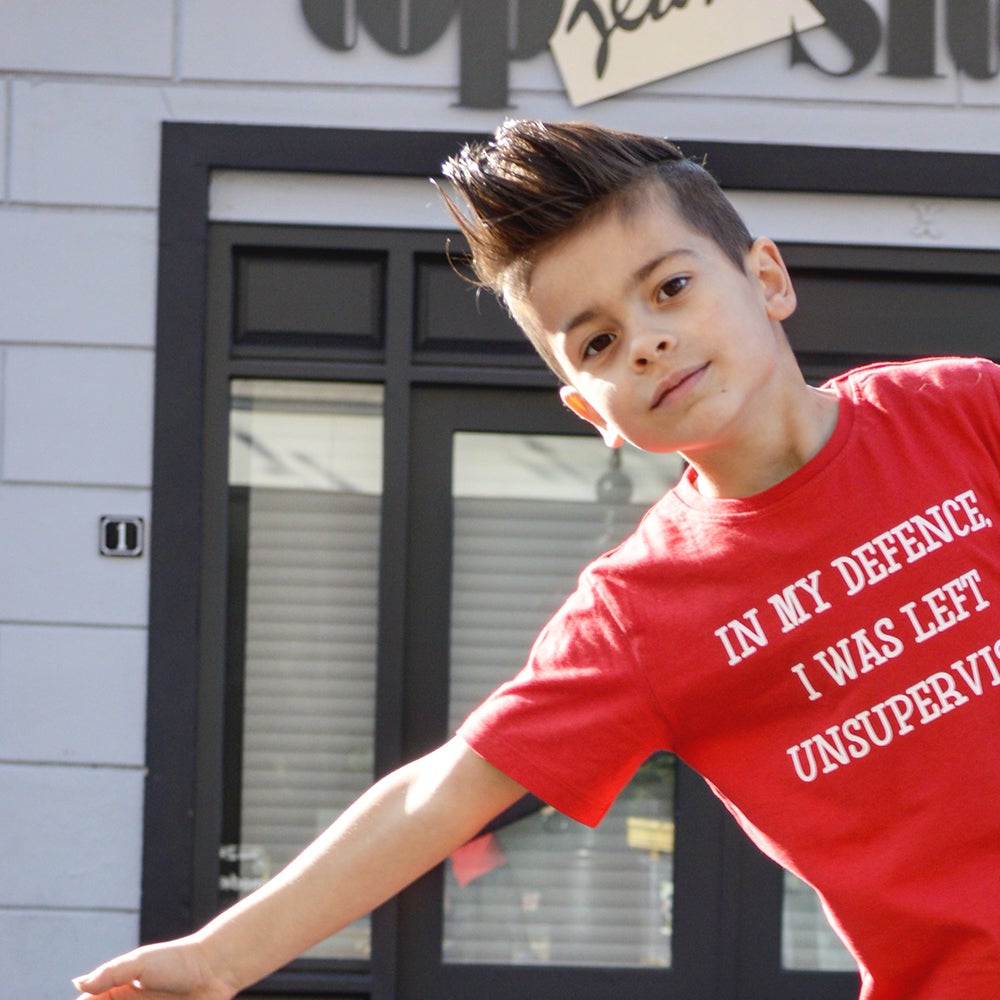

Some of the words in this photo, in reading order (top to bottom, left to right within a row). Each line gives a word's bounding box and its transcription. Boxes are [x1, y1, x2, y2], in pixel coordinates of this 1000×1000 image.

[714, 608, 768, 666] IN
[767, 570, 832, 633] MY
[831, 490, 993, 596] DEFENCE,
[791, 663, 822, 701] I
[813, 617, 904, 686] WAS
[900, 569, 990, 643] LEFT
